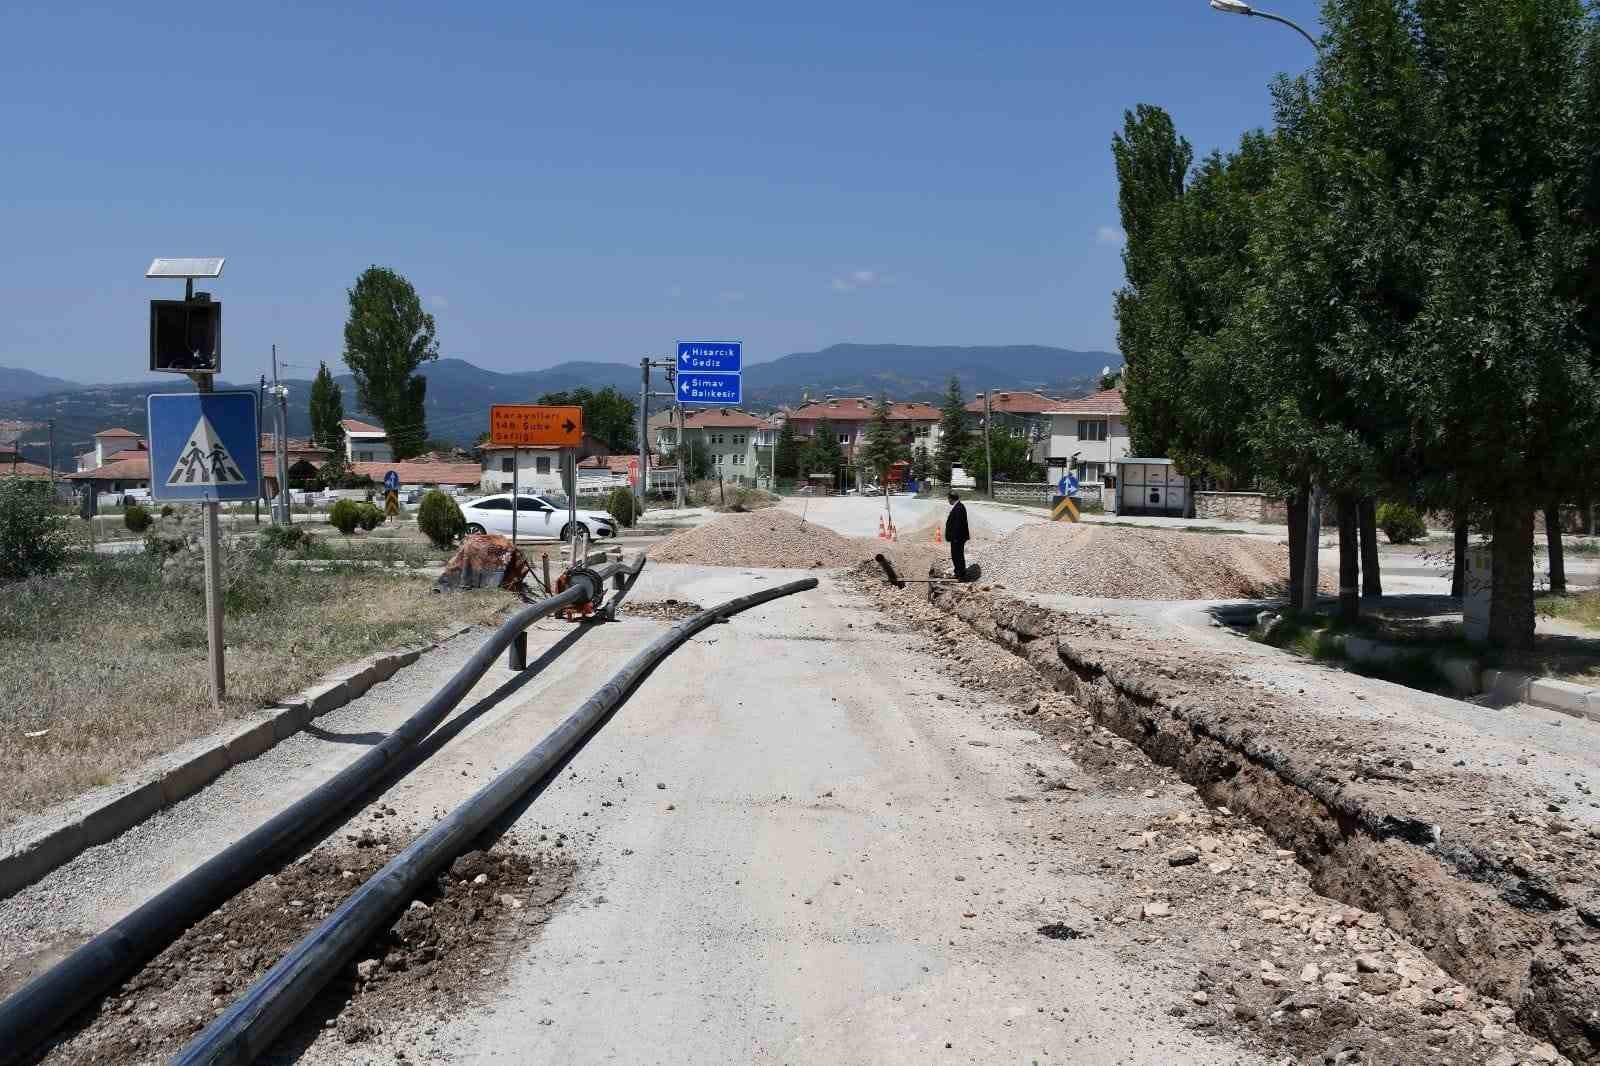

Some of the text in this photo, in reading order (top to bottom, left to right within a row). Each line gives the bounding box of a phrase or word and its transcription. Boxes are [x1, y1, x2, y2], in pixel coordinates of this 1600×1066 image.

[692, 347, 735, 356] Hisarcık
[692, 358, 721, 367] Gediz
[691, 379, 724, 387] Simav
[691, 389, 735, 398] Balıkesir
